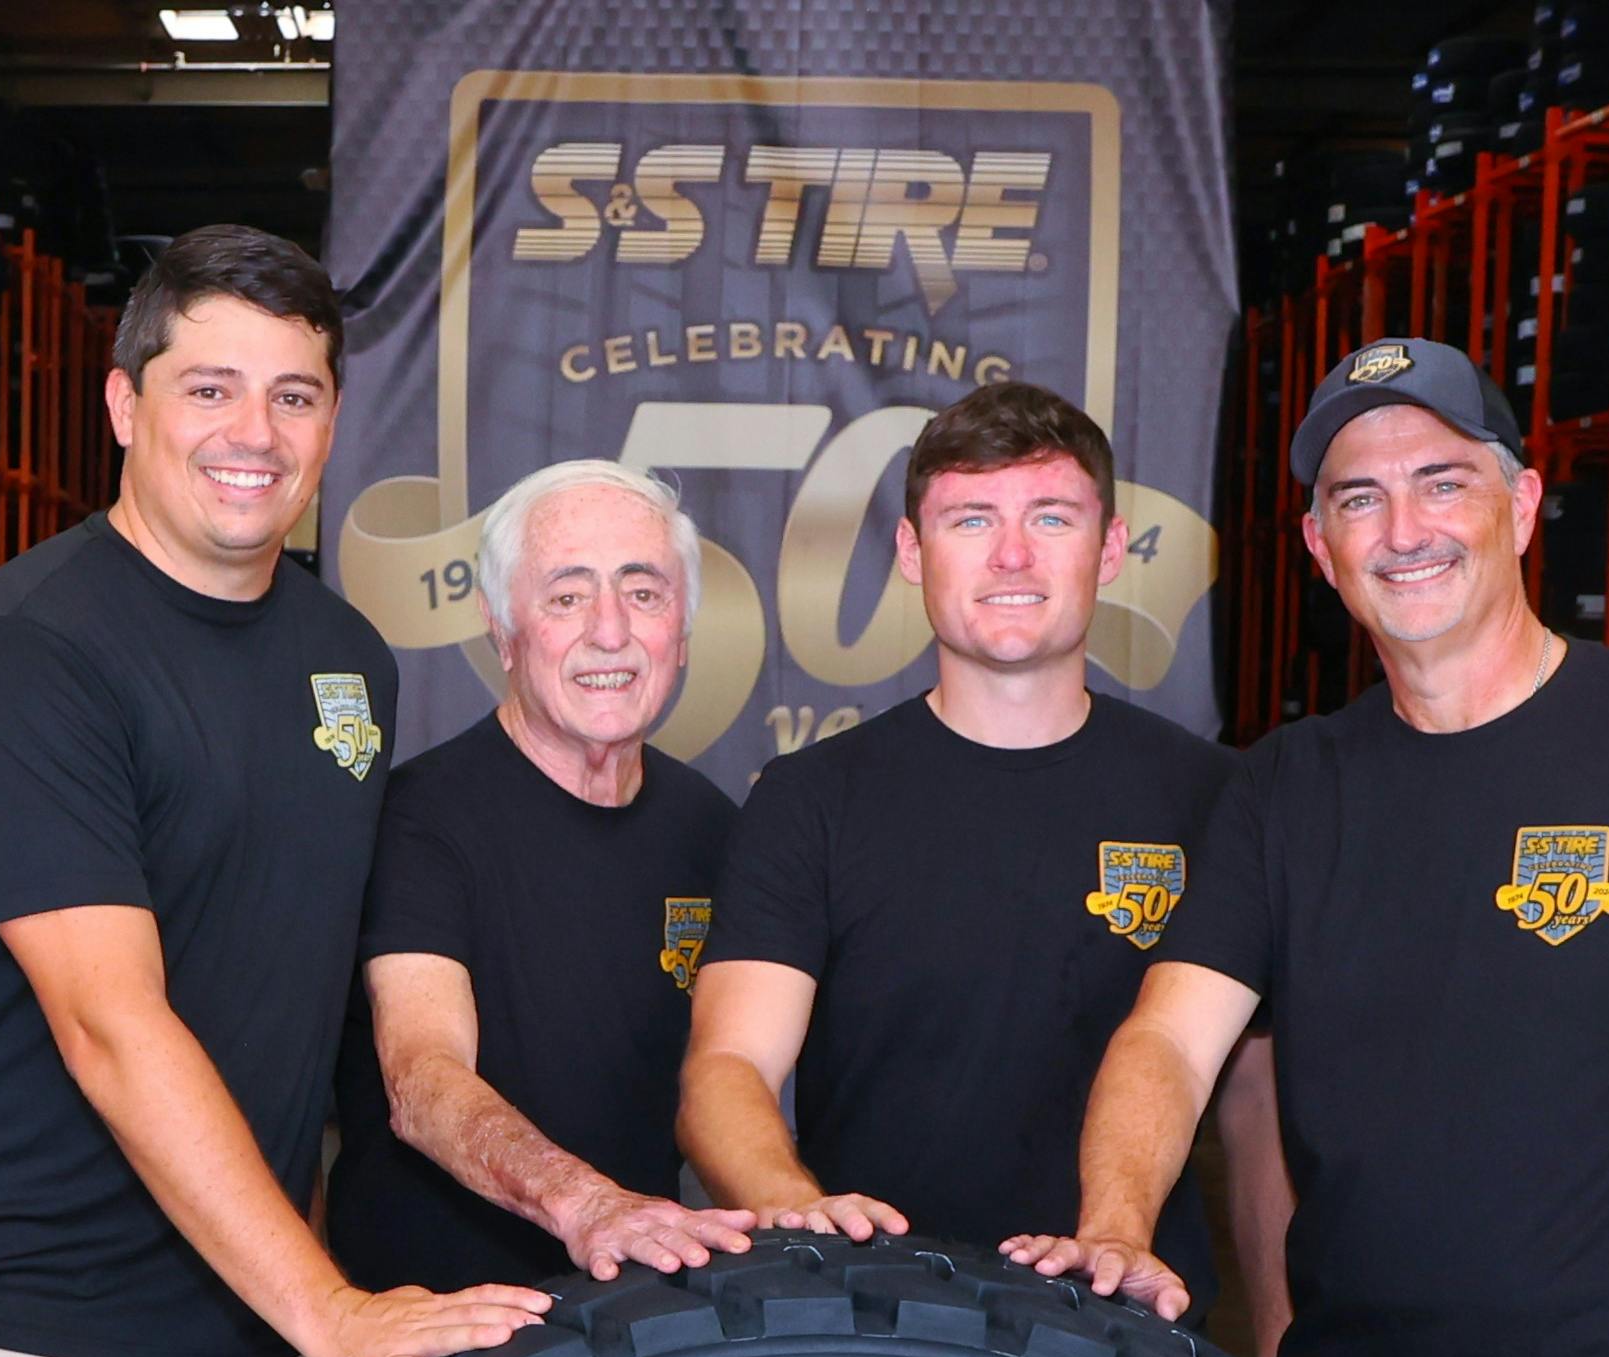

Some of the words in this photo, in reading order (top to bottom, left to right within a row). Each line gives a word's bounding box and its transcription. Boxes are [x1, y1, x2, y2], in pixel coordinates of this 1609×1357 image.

[512, 140, 726, 264] S&S
[559, 321, 1013, 383] CELEBRATING
[336, 714, 368, 768] 50
[1137, 853, 1176, 870] TIRE
[1555, 836, 1600, 856] TIRE
[1109, 883, 1170, 935] 50
[1517, 872, 1588, 930] 50
[1552, 913, 1590, 929] years
